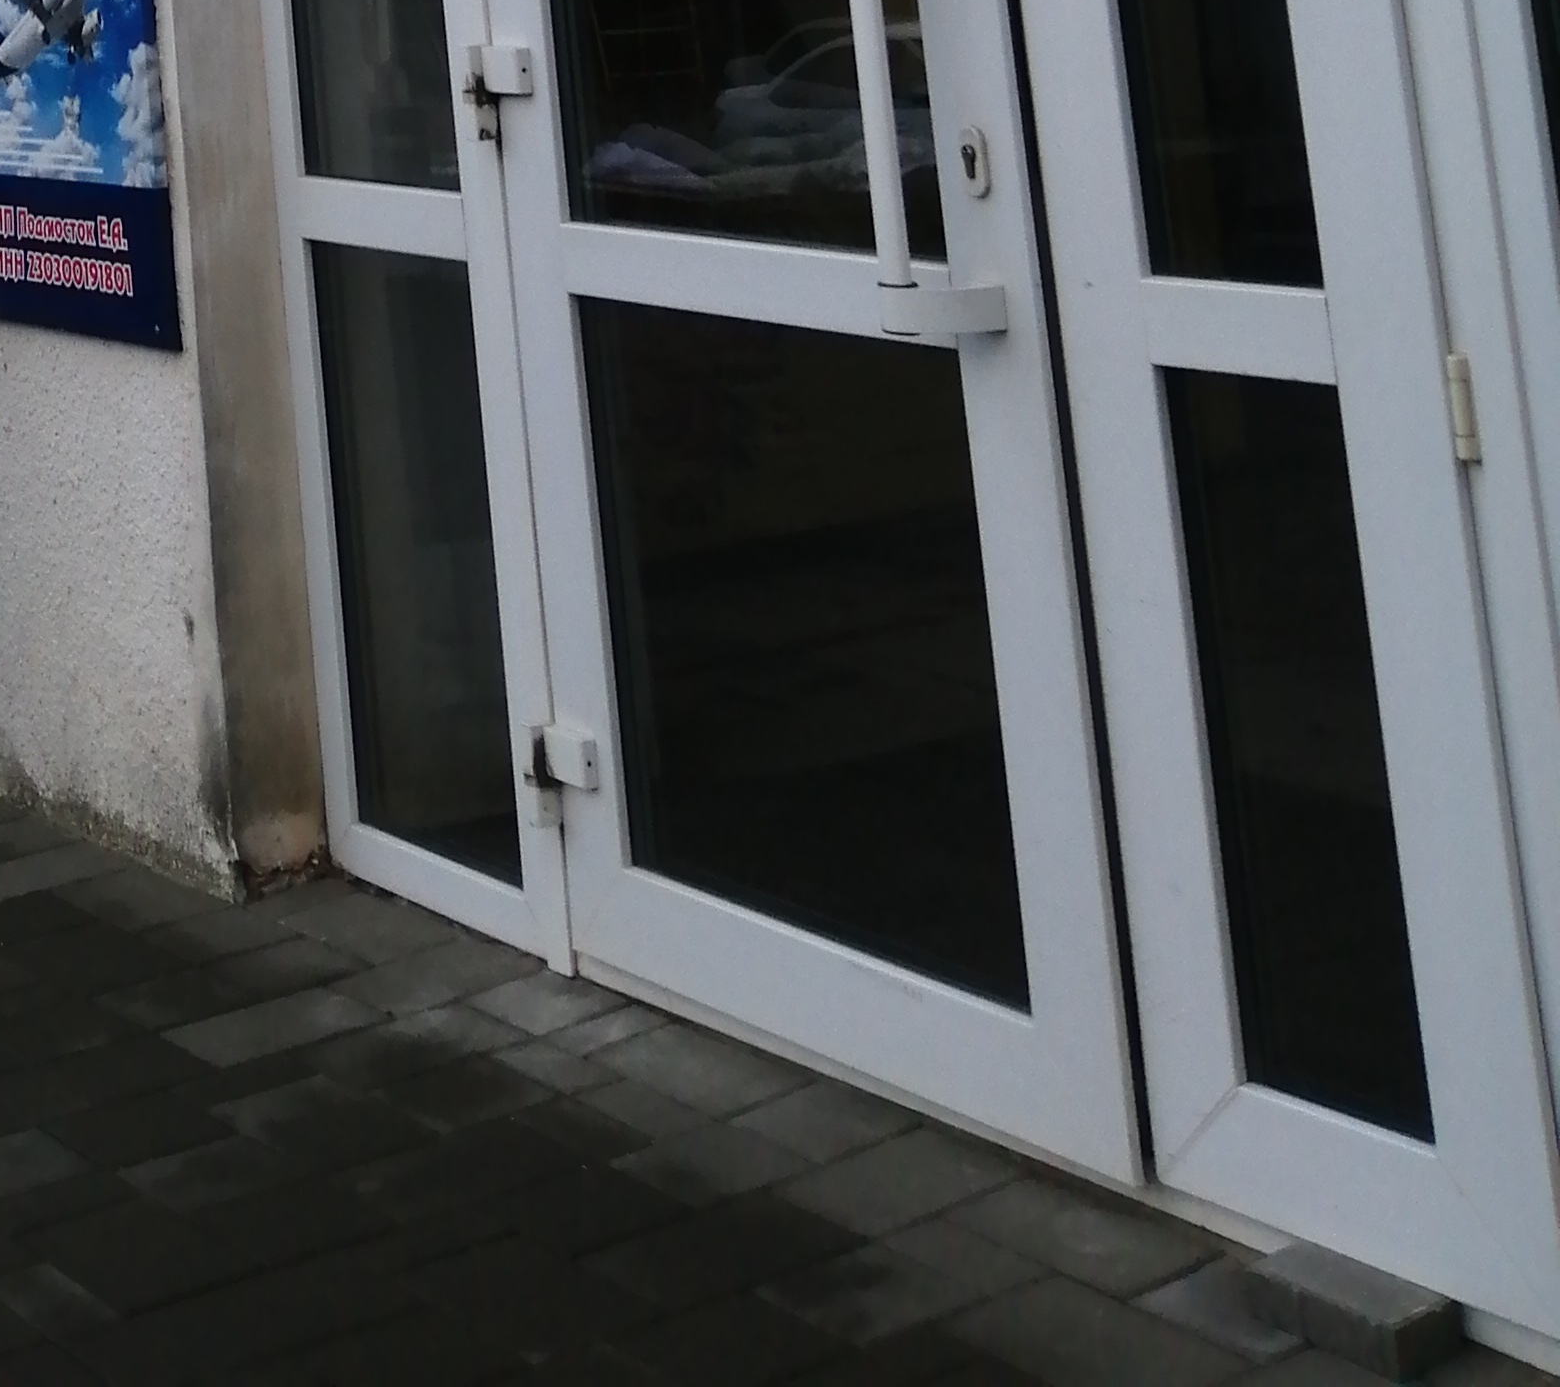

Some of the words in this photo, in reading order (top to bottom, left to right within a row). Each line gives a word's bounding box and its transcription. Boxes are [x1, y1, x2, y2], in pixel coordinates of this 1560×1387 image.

[16, 206, 96, 246] Подмосток
[97, 215, 129, 253] Е.А.
[27, 250, 133, 297] 230300191801
